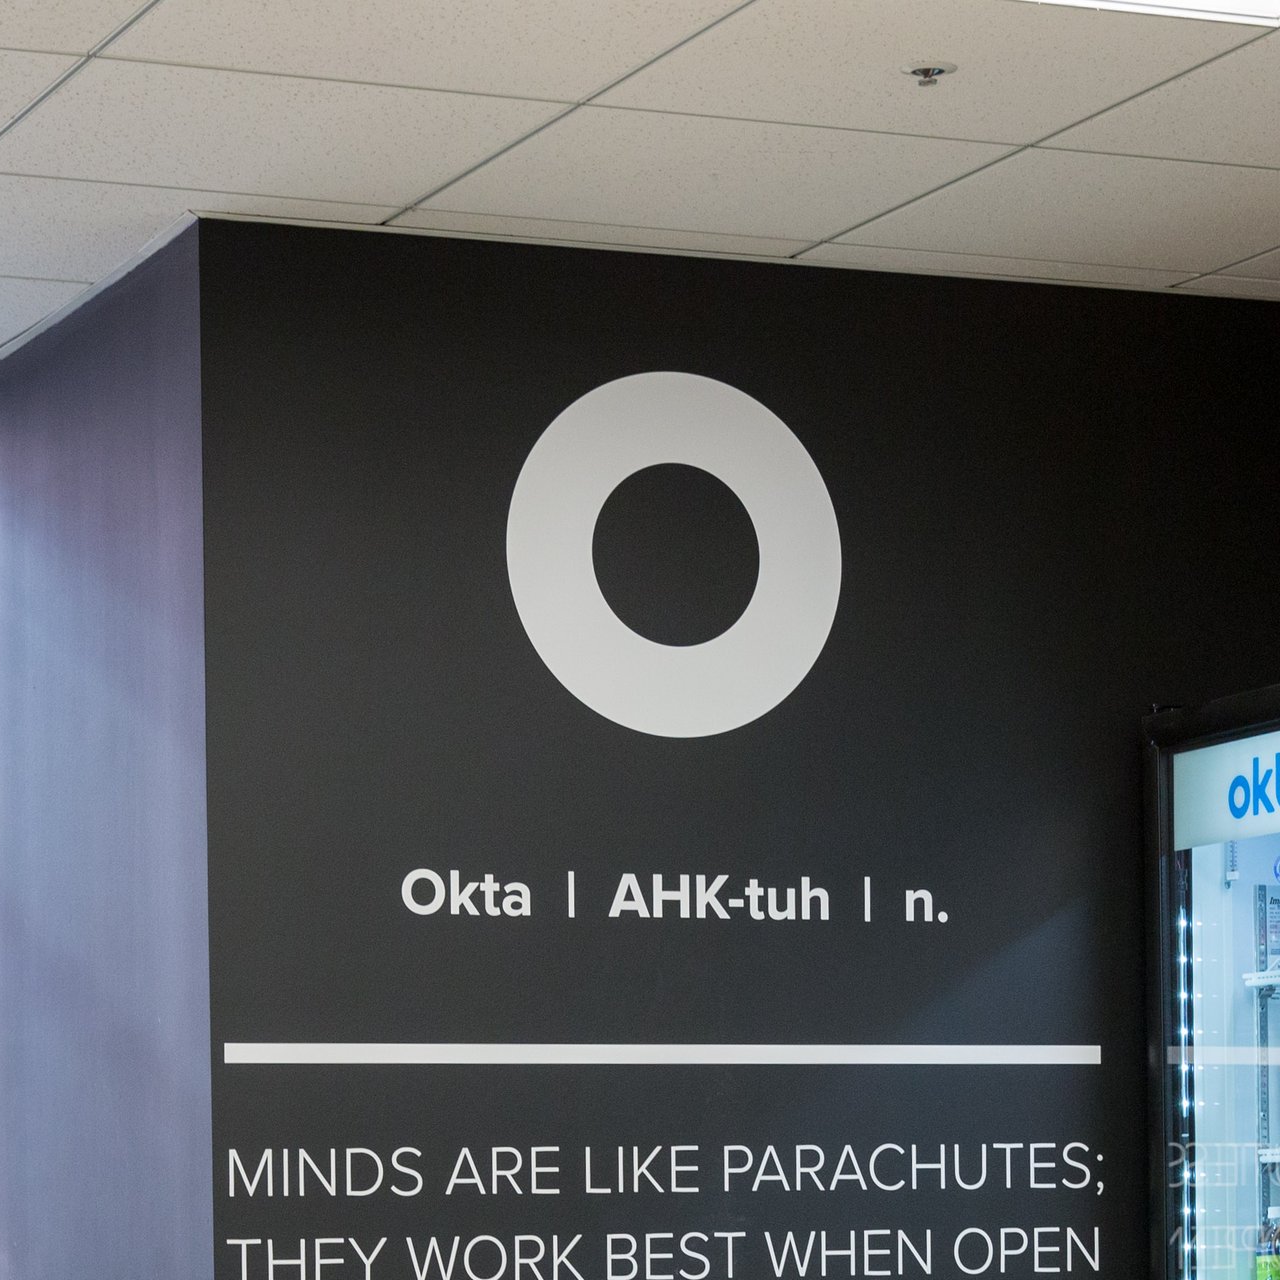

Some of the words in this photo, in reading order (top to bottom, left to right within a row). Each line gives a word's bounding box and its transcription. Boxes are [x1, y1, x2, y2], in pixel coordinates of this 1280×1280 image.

[402, 869, 532, 917] Okta
[609, 873, 830, 921] AHK-tuh
[905, 889, 949, 924] n.
[229, 1147, 423, 1197] MINDS
[446, 1146, 560, 1195] ARE
[586, 1145, 699, 1194] LIKE
[724, 1142, 1104, 1195] PARACHUTES;
[764, 1228, 932, 1278] WHEN
[953, 1226, 1100, 1275] OPEN
